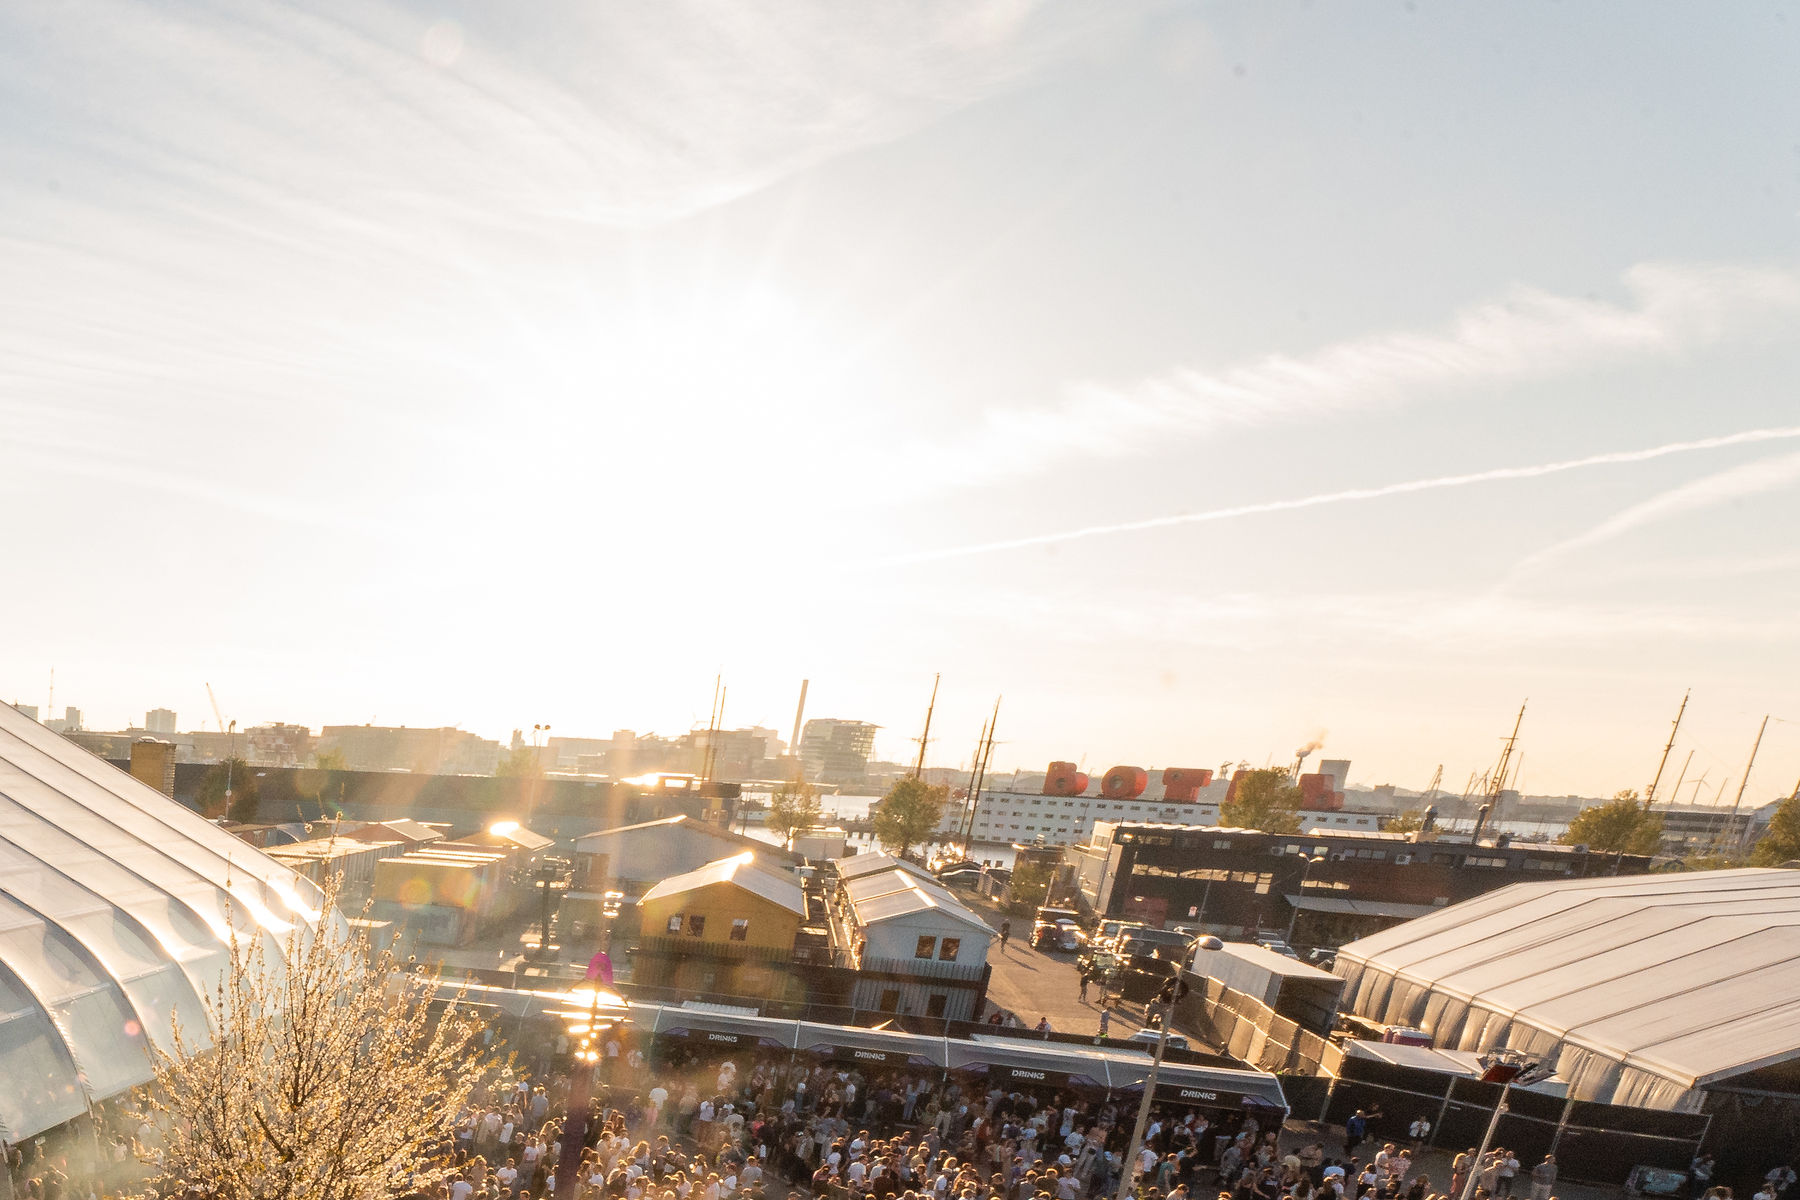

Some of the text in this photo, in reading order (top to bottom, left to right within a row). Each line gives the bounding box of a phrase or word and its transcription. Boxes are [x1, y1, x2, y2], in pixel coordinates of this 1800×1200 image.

[1042, 760, 1346, 811] BOTL
[708, 1033, 739, 1043] DRINKS
[854, 1050, 886, 1061] DRINKS
[1011, 1069, 1046, 1080] DRINKS
[1180, 1089, 1217, 1101] DRINKS
